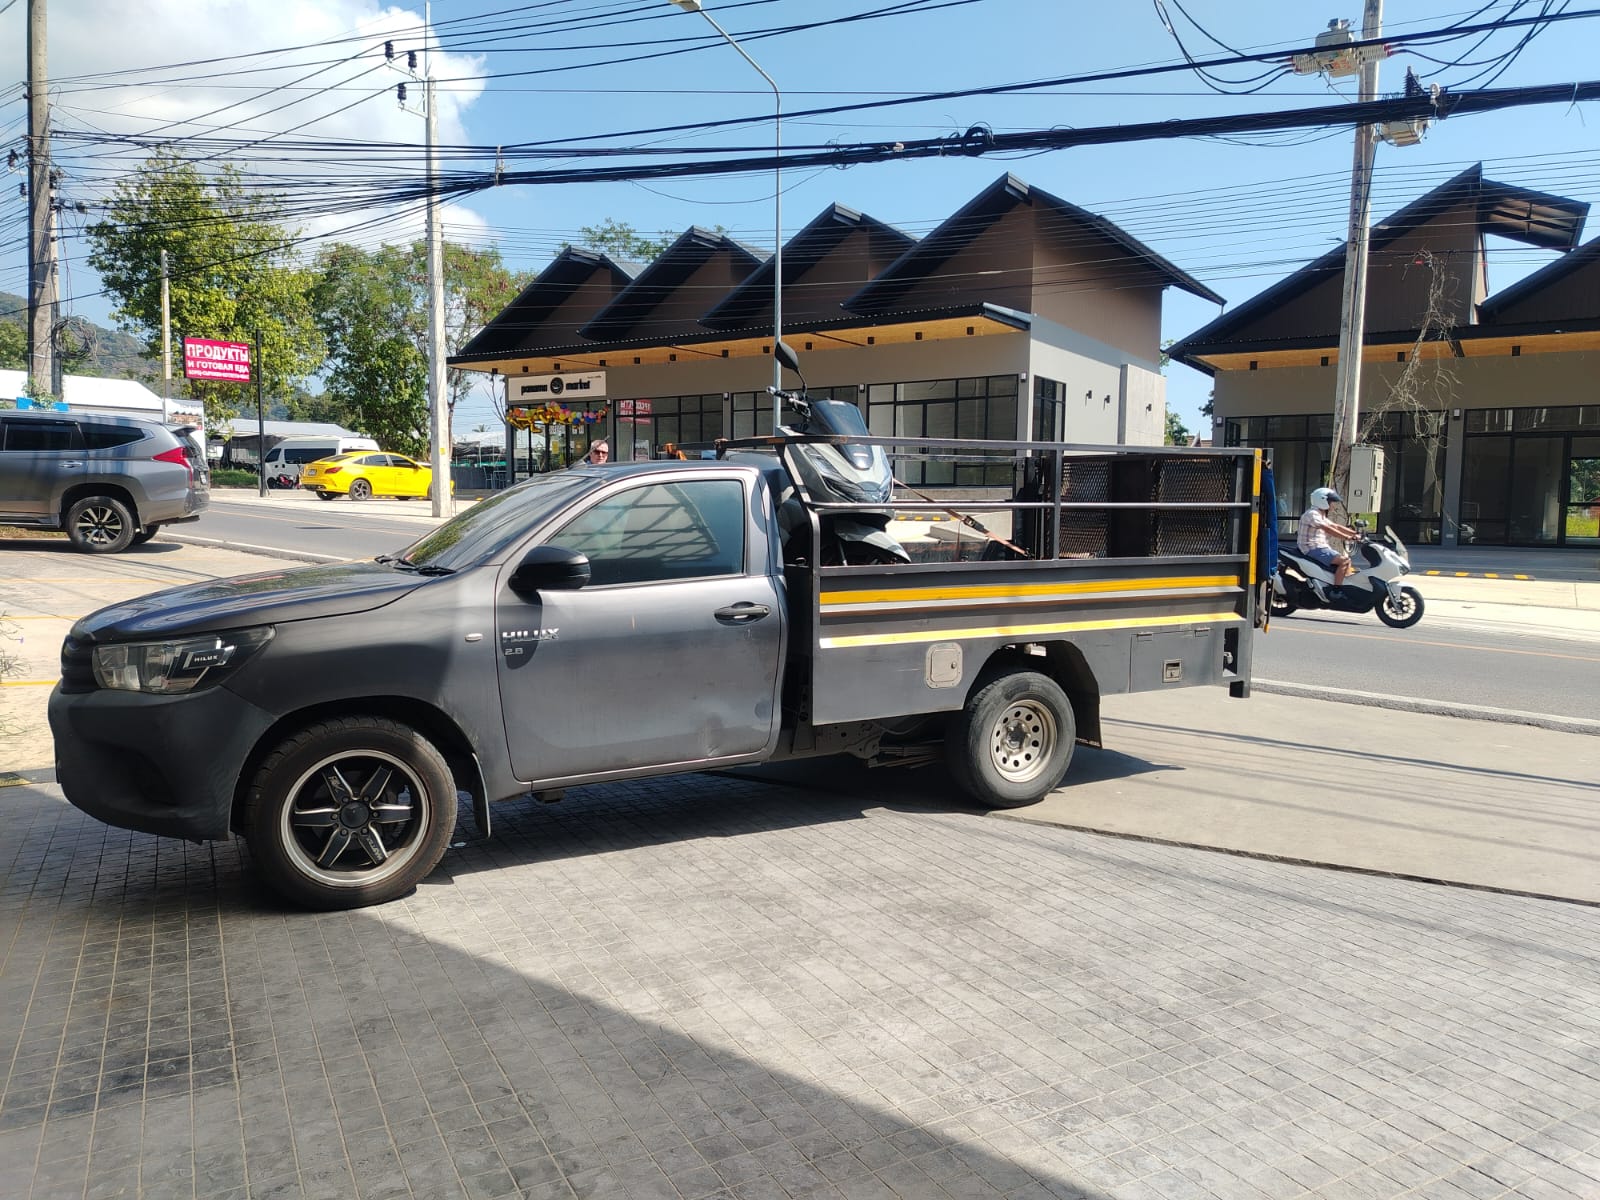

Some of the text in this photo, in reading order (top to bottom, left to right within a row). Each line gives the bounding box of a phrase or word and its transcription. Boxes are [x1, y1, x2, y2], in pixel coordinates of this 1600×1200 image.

[186, 343, 248, 362] ПРОДУКТЫ
[196, 361, 233, 370] ГОТОВАЯ
[234, 364, 249, 373] ЕДА
[502, 628, 559, 642] HILUX
